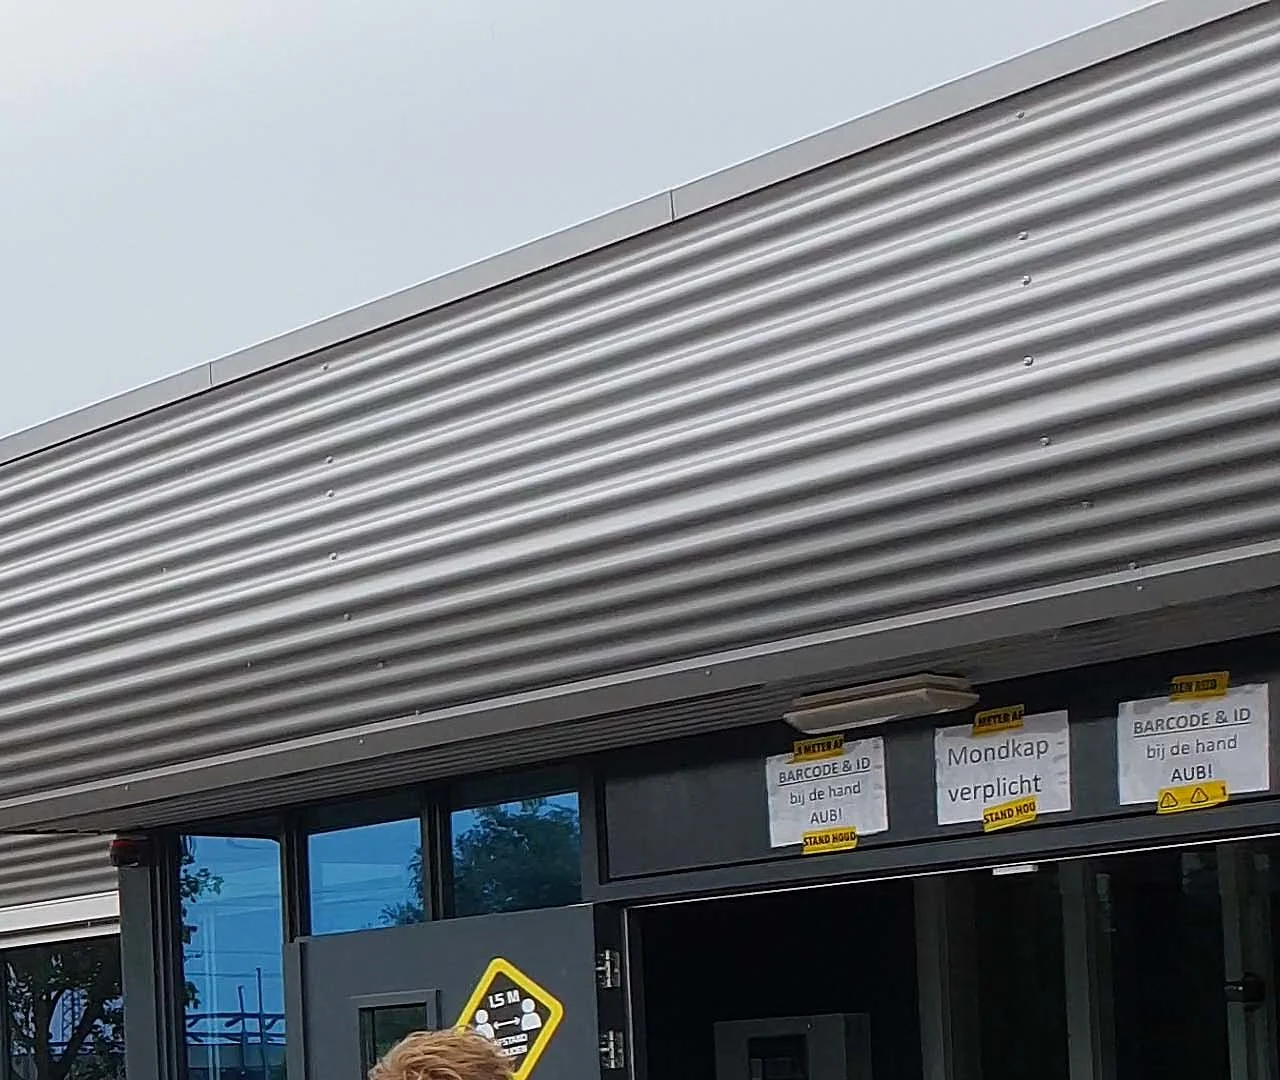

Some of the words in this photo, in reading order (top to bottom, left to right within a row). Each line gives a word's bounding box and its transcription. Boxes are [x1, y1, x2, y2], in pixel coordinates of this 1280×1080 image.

[1134, 712, 1209, 734] BARCODE
[1216, 711, 1228, 723] &
[1234, 708, 1251, 721] ID
[948, 738, 1049, 766] Mondkap
[1147, 744, 1165, 760] bij
[1170, 740, 1190, 756] de
[1196, 735, 1237, 753] hand
[779, 762, 838, 783] BARCODE
[842, 760, 852, 772] &
[857, 757, 870, 770] ID
[1171, 764, 1212, 782] AUB!
[790, 792, 805, 806] bij
[809, 787, 824, 801] de
[829, 781, 861, 798] hand
[948, 775, 1042, 803] verplicht
[810, 808, 842, 825] AUB!
